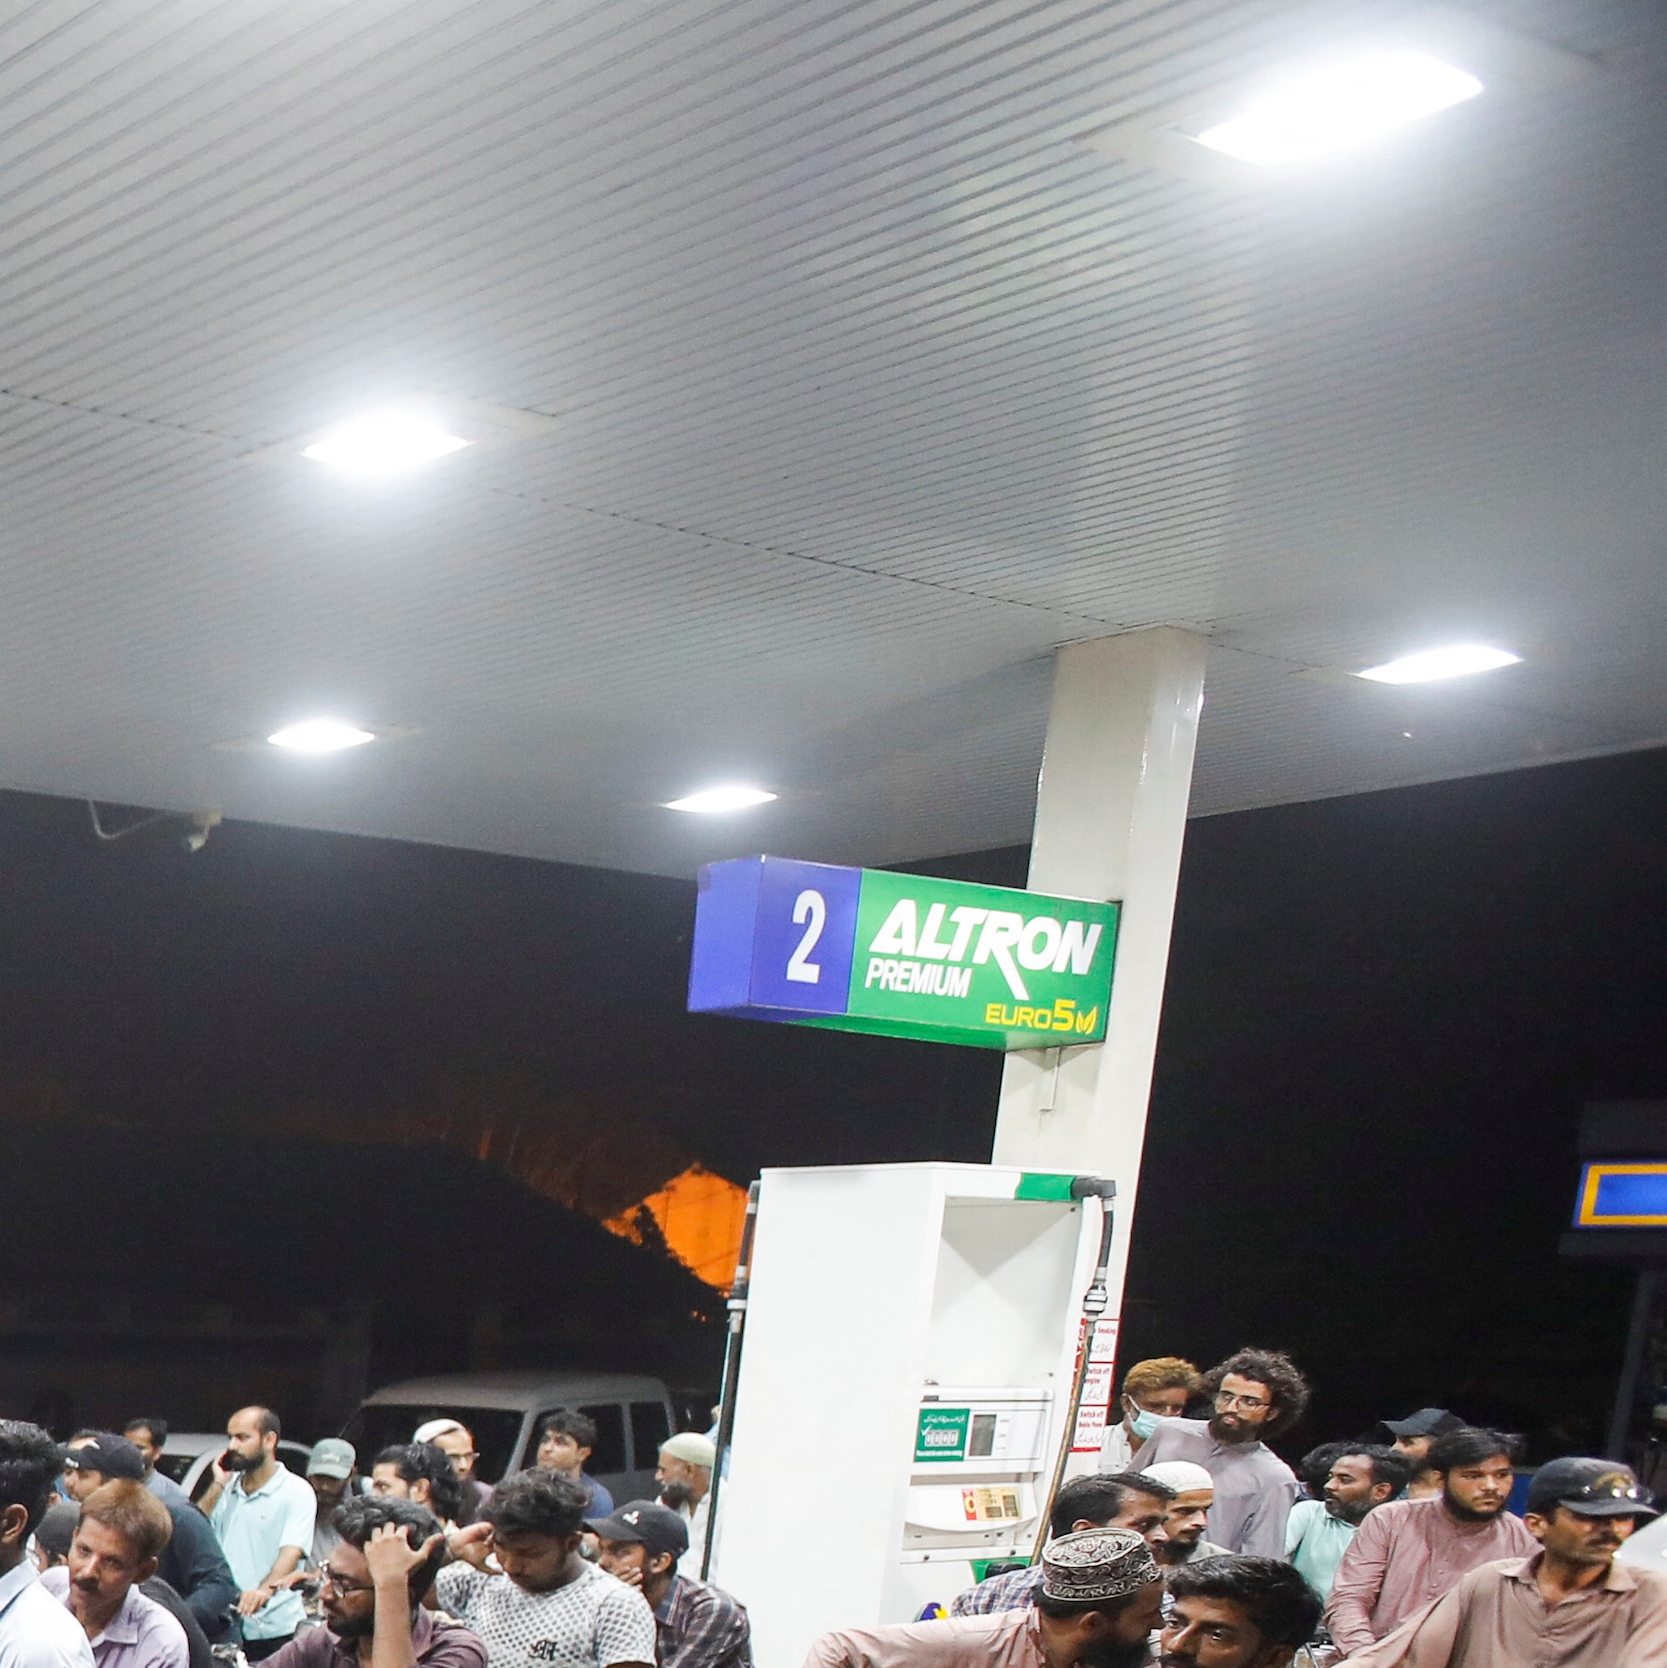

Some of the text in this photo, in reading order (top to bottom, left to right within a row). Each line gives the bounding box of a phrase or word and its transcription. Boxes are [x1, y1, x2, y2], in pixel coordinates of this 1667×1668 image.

[786, 889, 826, 984] 2
[865, 958, 972, 999] PREMIUM
[868, 898, 1103, 1001] ALTRON
